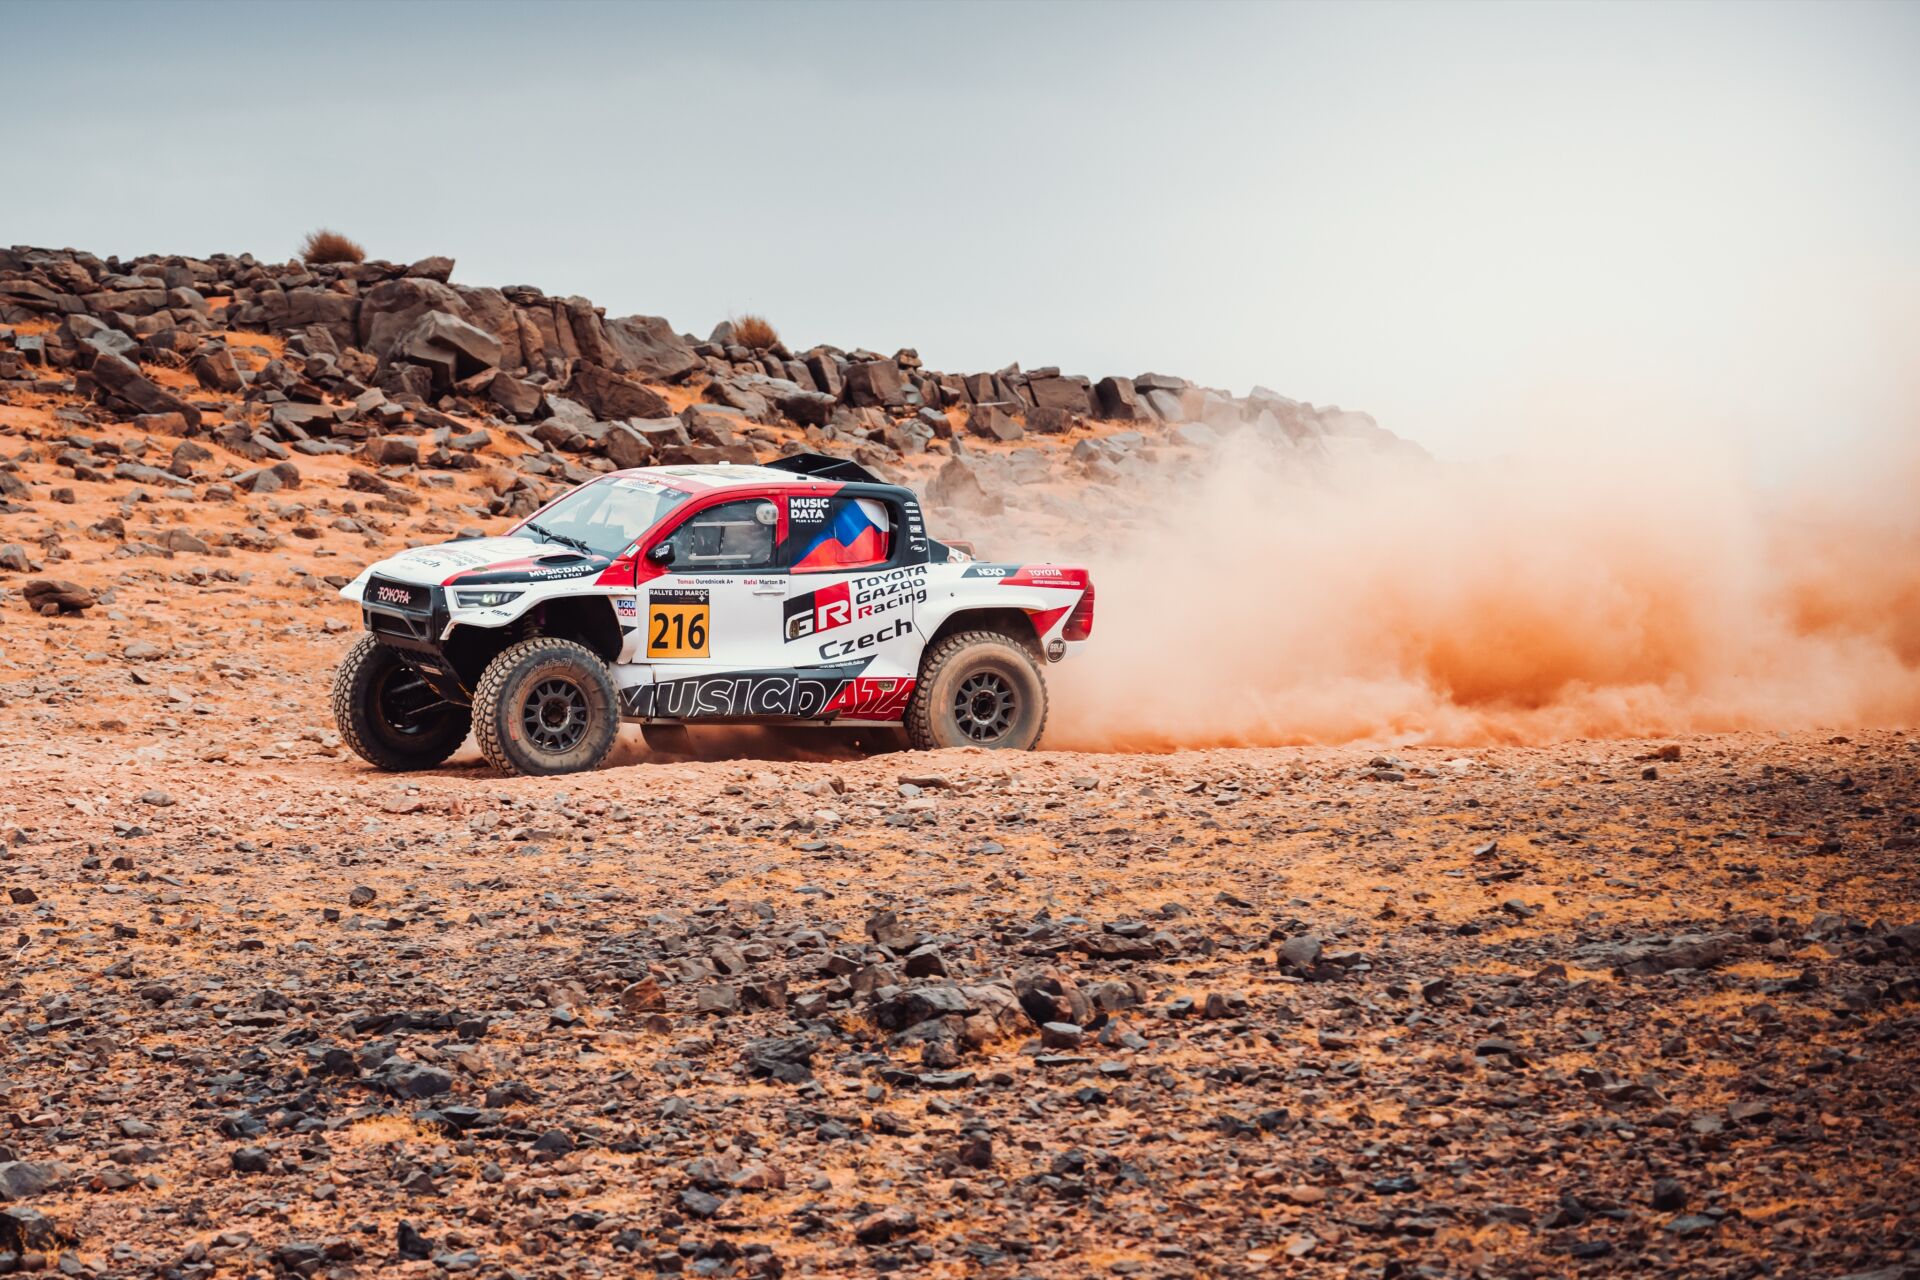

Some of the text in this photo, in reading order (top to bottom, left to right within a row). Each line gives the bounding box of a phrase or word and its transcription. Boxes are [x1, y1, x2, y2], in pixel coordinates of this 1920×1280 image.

[790, 498, 829, 508] MUSIC
[790, 508, 825, 519] DATA
[529, 565, 594, 578] MUSICDATA
[852, 565, 928, 590] TOYOTA
[378, 587, 410, 604] TOYOTA
[855, 578, 925, 605] GAZOO
[857, 589, 927, 619] Racing
[618, 608, 636, 616] MOLY
[785, 600, 849, 639] GR
[651, 612, 705, 650] 216
[818, 618, 913, 660] Czech
[620, 678, 917, 719] MUSICDATA
